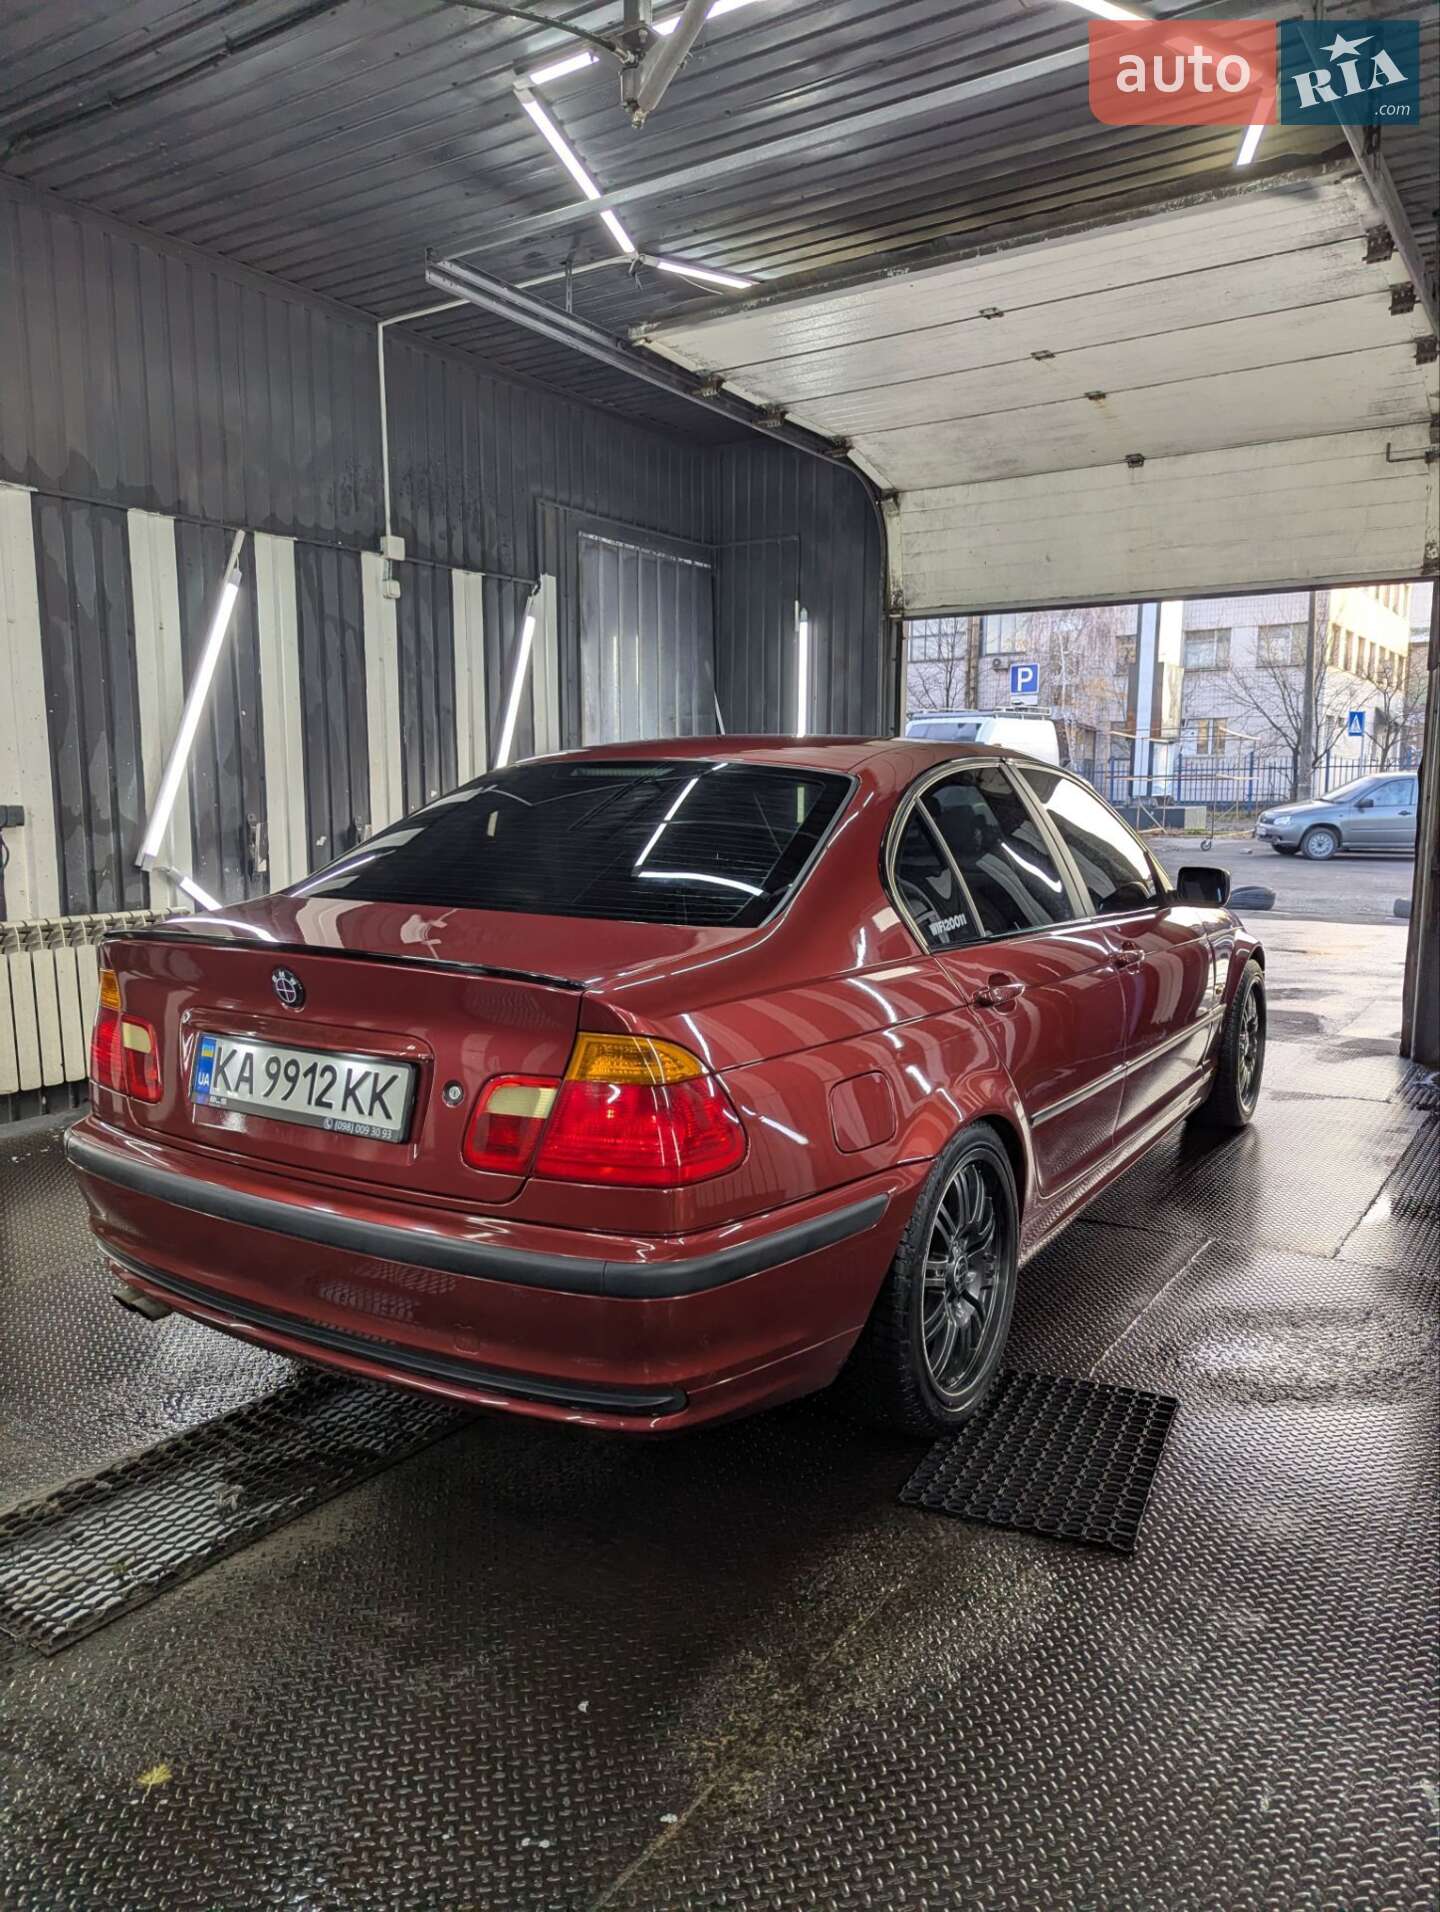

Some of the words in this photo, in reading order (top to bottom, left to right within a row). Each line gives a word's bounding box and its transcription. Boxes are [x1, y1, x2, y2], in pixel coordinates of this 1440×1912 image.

[1017, 667, 1034, 692] P
[198, 1071, 210, 1087] UA
[213, 1046, 255, 1097] KA
[263, 1055, 338, 1109] 9912
[341, 1067, 399, 1120] KK
